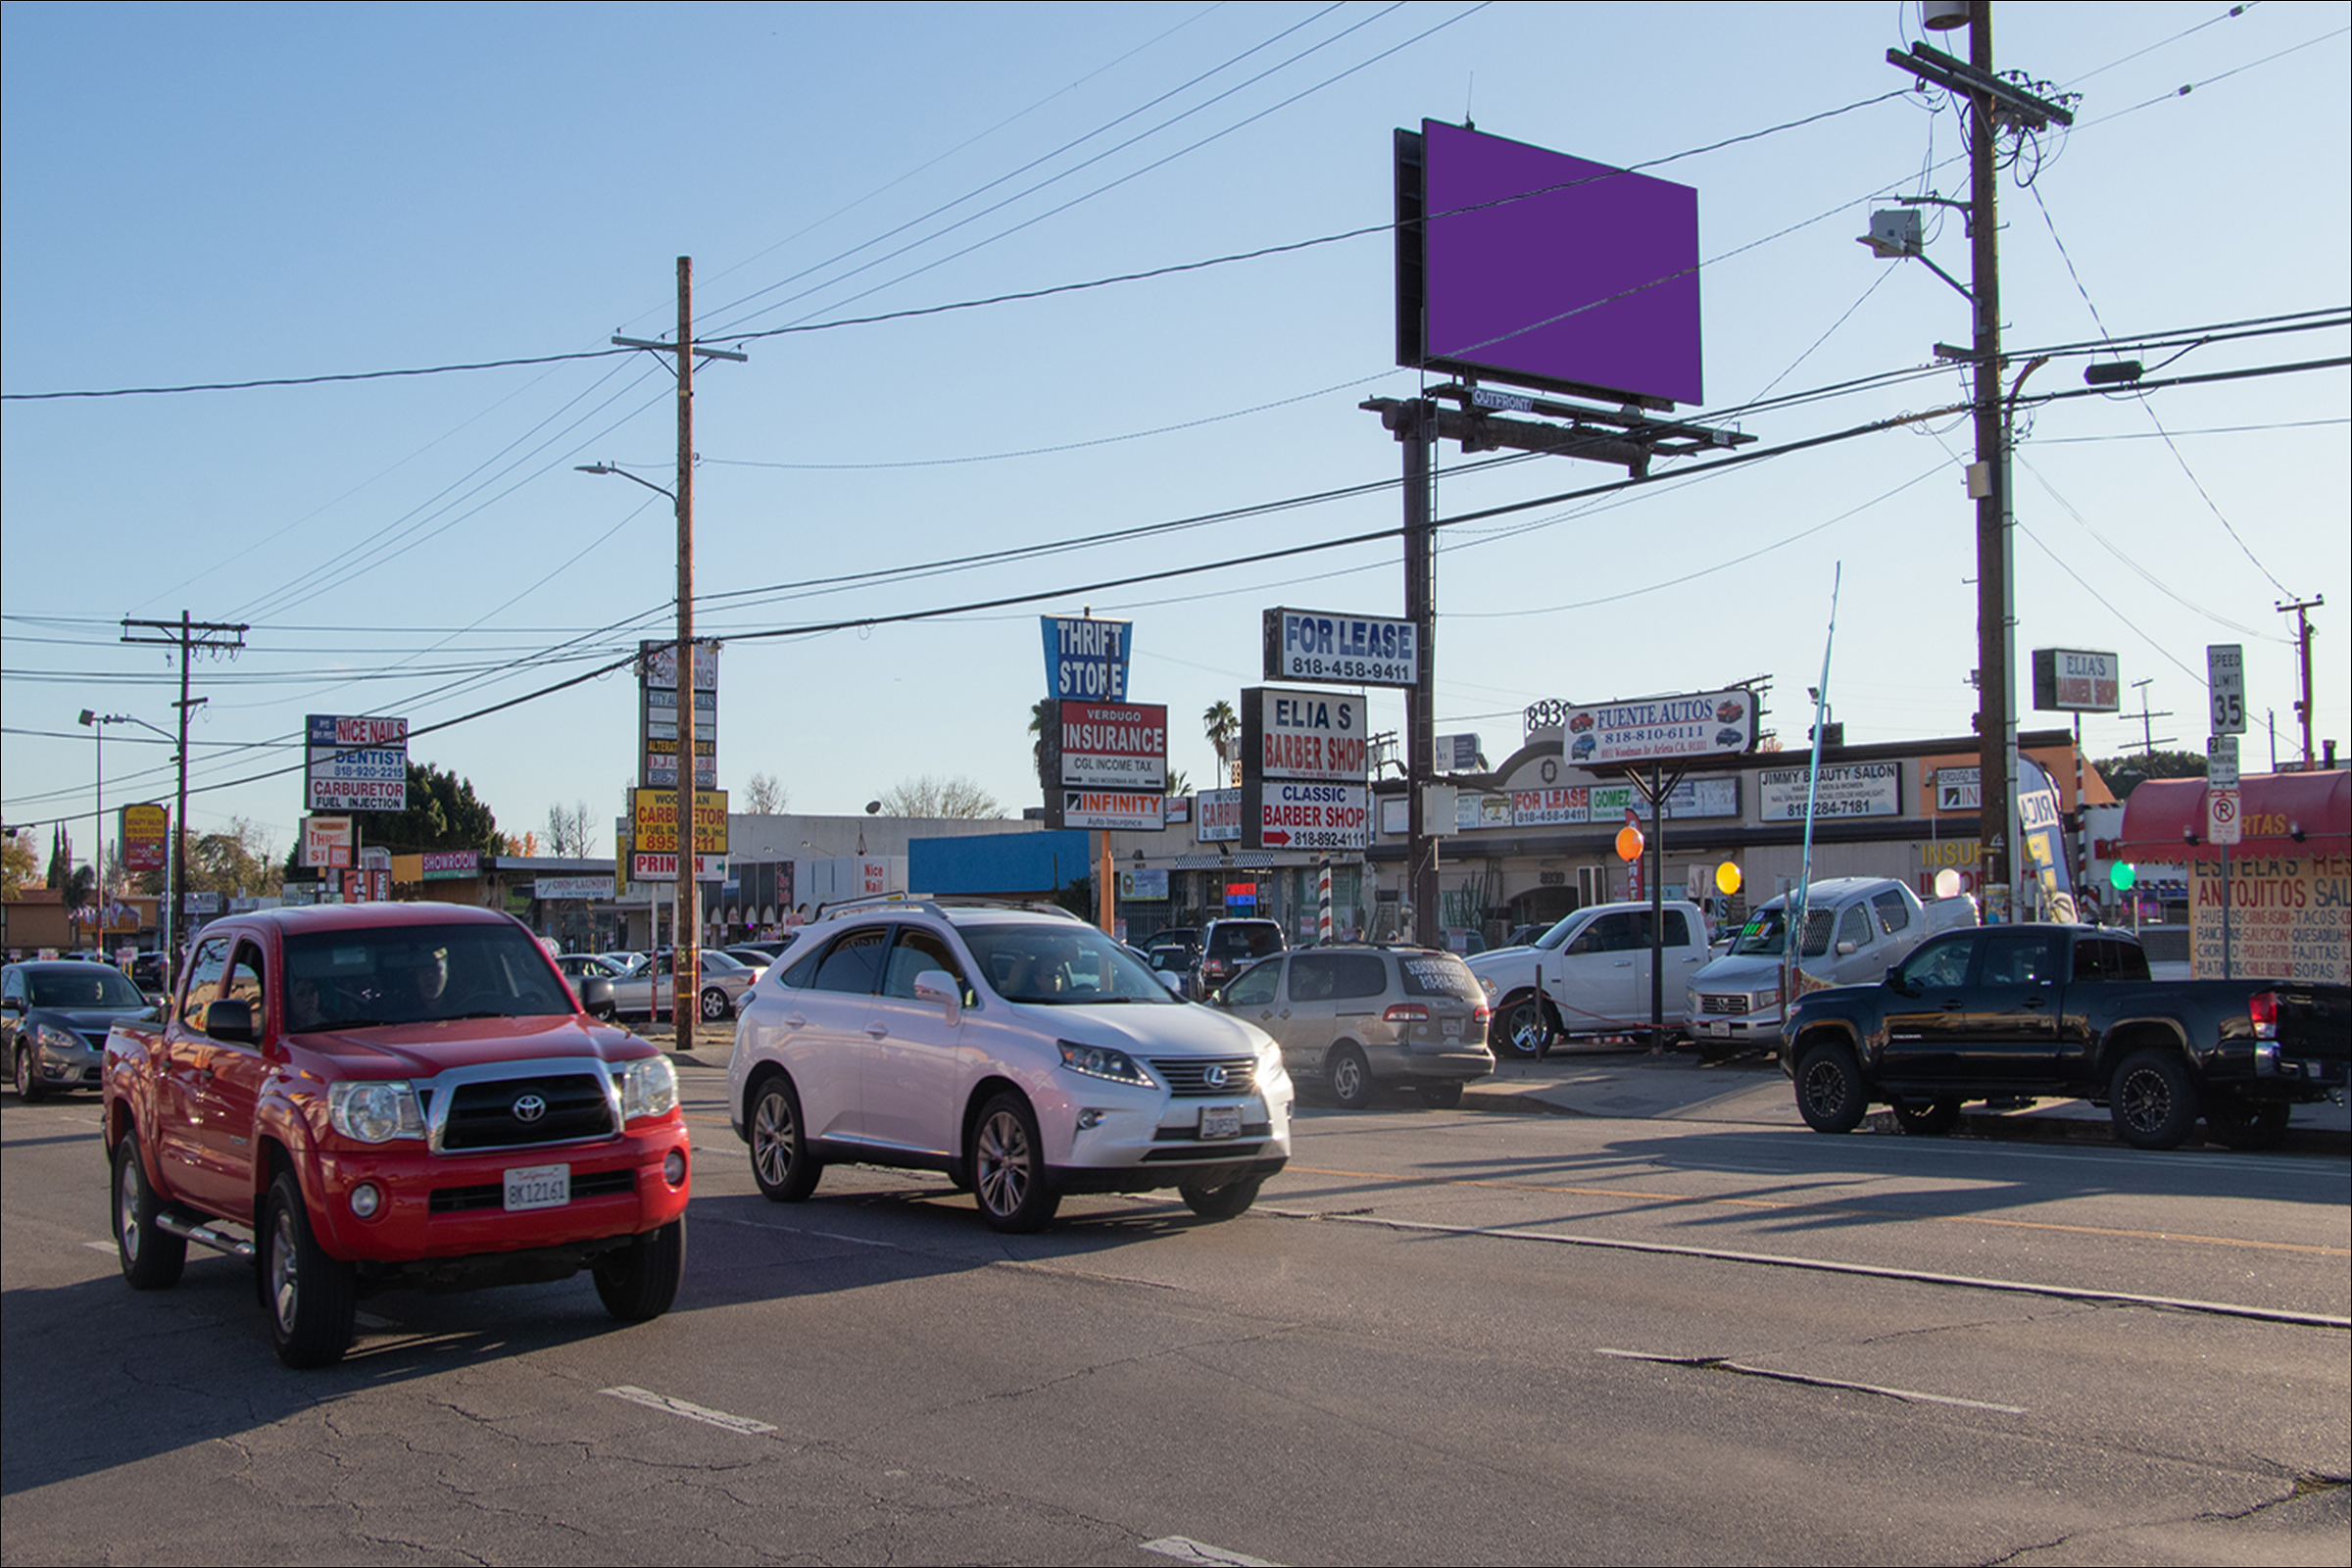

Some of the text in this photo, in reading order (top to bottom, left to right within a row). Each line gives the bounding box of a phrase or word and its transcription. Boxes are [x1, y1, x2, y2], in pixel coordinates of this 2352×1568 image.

[1474, 390, 1530, 412] OUTFRONT
[1057, 620, 1123, 658] THRIFT
[1286, 616, 1413, 661] FOR LEASE
[1293, 657, 1409, 681] 818-458-9411
[2067, 656, 2106, 676] ELIA'S
[2211, 654, 2240, 667] SPEED
[1058, 660, 1123, 697] STORE
[2213, 673, 2239, 688] LIMIT
[1087, 709, 1142, 722] VERDUGO
[1276, 699, 1352, 730] ELIA S
[1596, 699, 1713, 729] FUENTE AUTOS
[2214, 694, 2242, 726] 35
[337, 719, 367, 742] NICE
[368, 720, 405, 744] NAILS
[1062, 723, 1163, 754] INSURANCE
[1604, 725, 1704, 745] 818-810-6111
[1264, 733, 1365, 772] BARBER SHOP
[2210, 738, 2218, 752] 2
[335, 750, 405, 765] DENTIST
[1074, 758, 1152, 772] CGL INCOME TAX
[334, 765, 404, 778] 818-920-2215
[1762, 764, 1895, 786] JIMMY BAUTY SALON
[314, 780, 404, 798] CARBURETOR
[1282, 785, 1347, 803] CLASSIC
[316, 797, 401, 808] FUEL INJECTION
[655, 794, 710, 806] WOOAN
[1082, 793, 1161, 813] INFINITY
[1514, 787, 1589, 811] FOR LEASE
[1593, 789, 1631, 808] GOMEZ
[1087, 816, 1143, 827] Auto Insurance
[1263, 805, 1365, 829] BARBER SHOP
[1517, 808, 1587, 823] 818-458-9411
[645, 825, 664, 835] FUEL
[711, 827, 726, 838] Inc.
[1294, 831, 1365, 847] 818-892-4111
[646, 834, 715, 852] 895-211
[423, 853, 477, 870] SHOWROOM
[863, 863, 884, 877] Nice
[574, 877, 613, 890] LAUNDRY
[2197, 878, 2307, 907] ANTOJITOS
[2200, 909, 2242, 925] HUEOS
[2243, 910, 2267, 924] CARNE
[2268, 909, 2291, 925] ASADA
[2294, 908, 2338, 925] TACOS
[2243, 927, 2289, 943] SALPICON
[2244, 944, 2265, 958] POLLO
[2267, 945, 2290, 959] FRITO
[2292, 945, 2339, 961] FAJITAS
[2294, 962, 2335, 979] SOPAS
[509, 1180, 565, 1205] 8K12161
